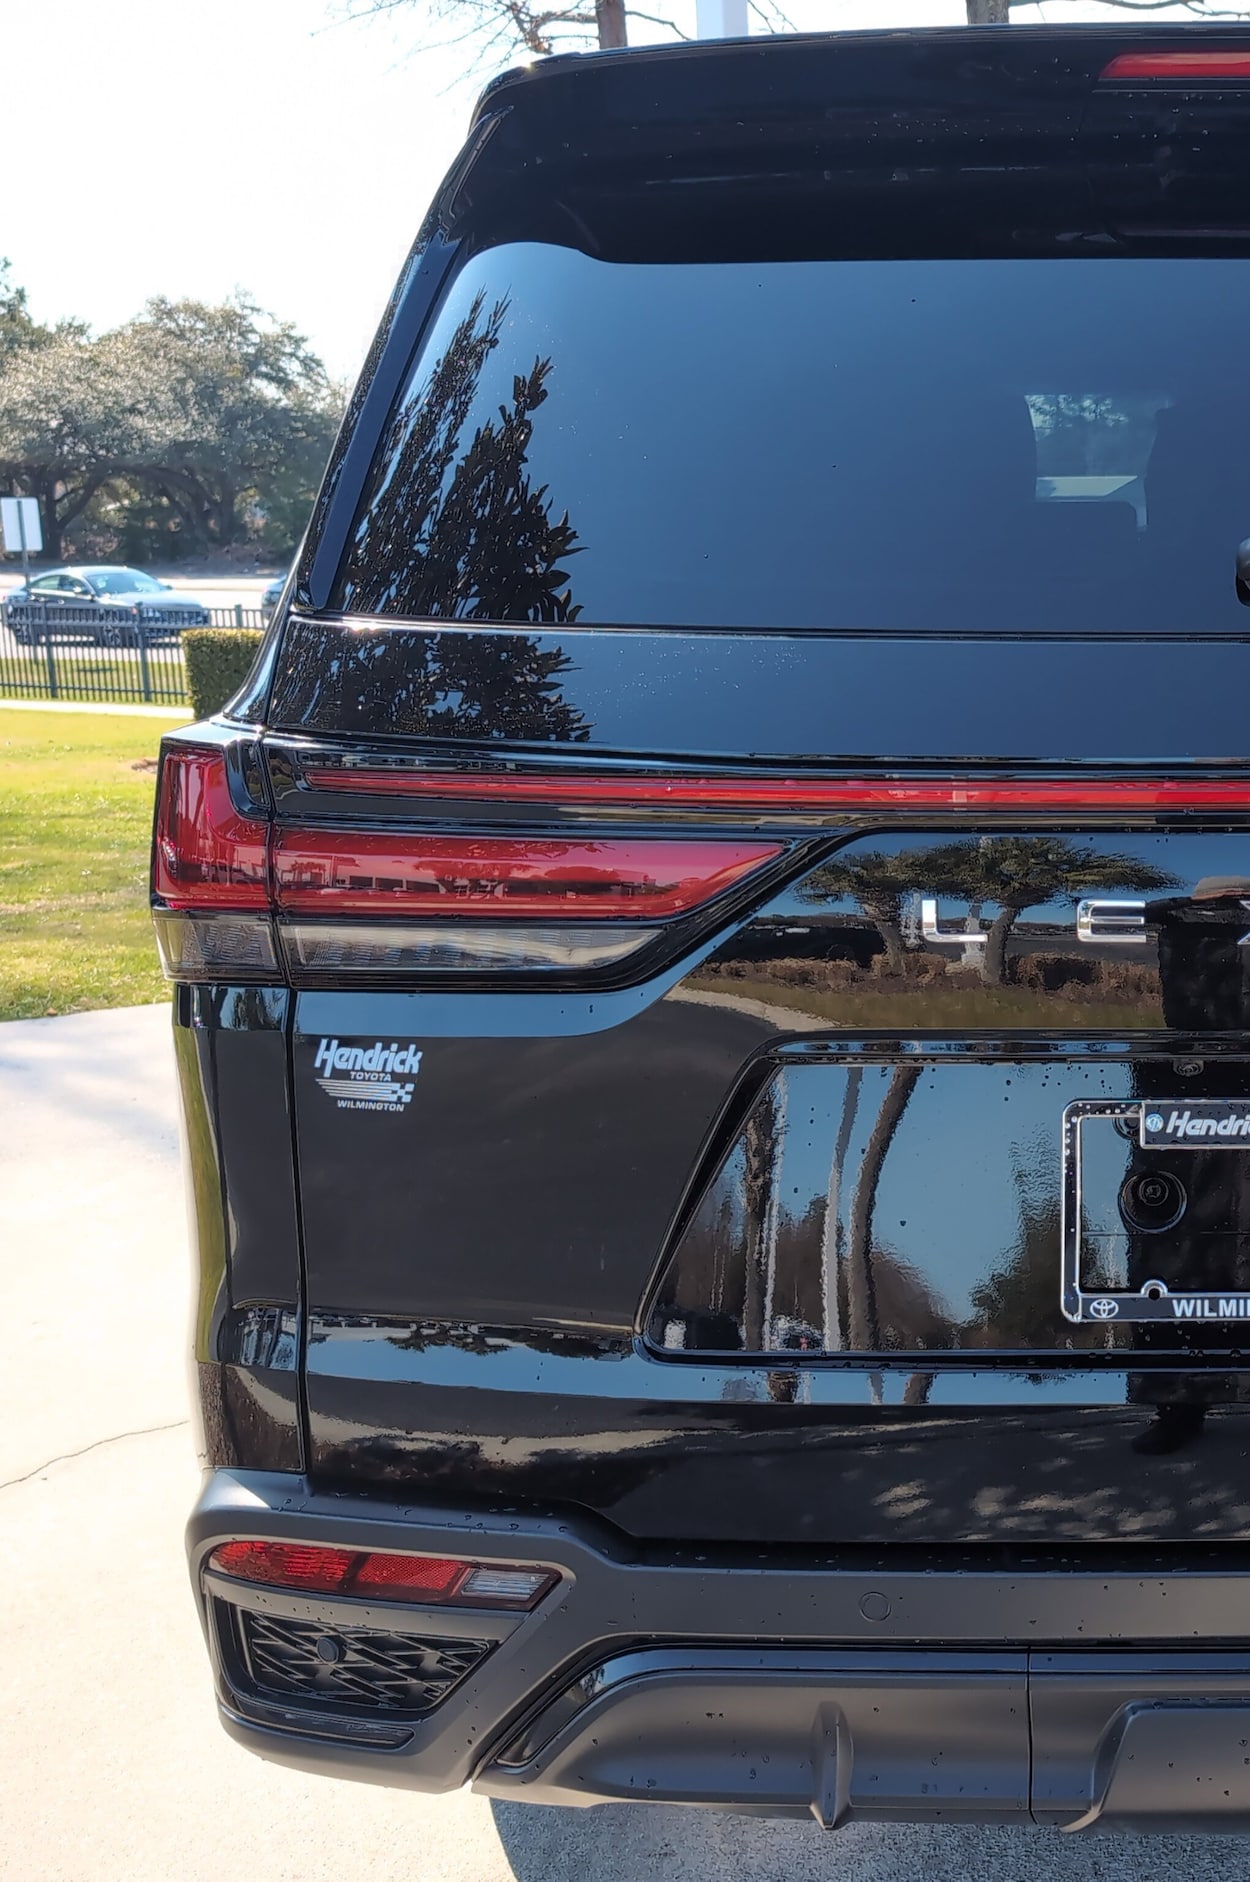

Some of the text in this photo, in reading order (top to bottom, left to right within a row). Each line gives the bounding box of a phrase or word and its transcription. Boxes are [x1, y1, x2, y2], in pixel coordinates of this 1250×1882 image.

[314, 1038, 423, 1078] Hendrick
[350, 1071, 391, 1082] TOYOTA
[337, 1100, 405, 1112] WILMINGTON
